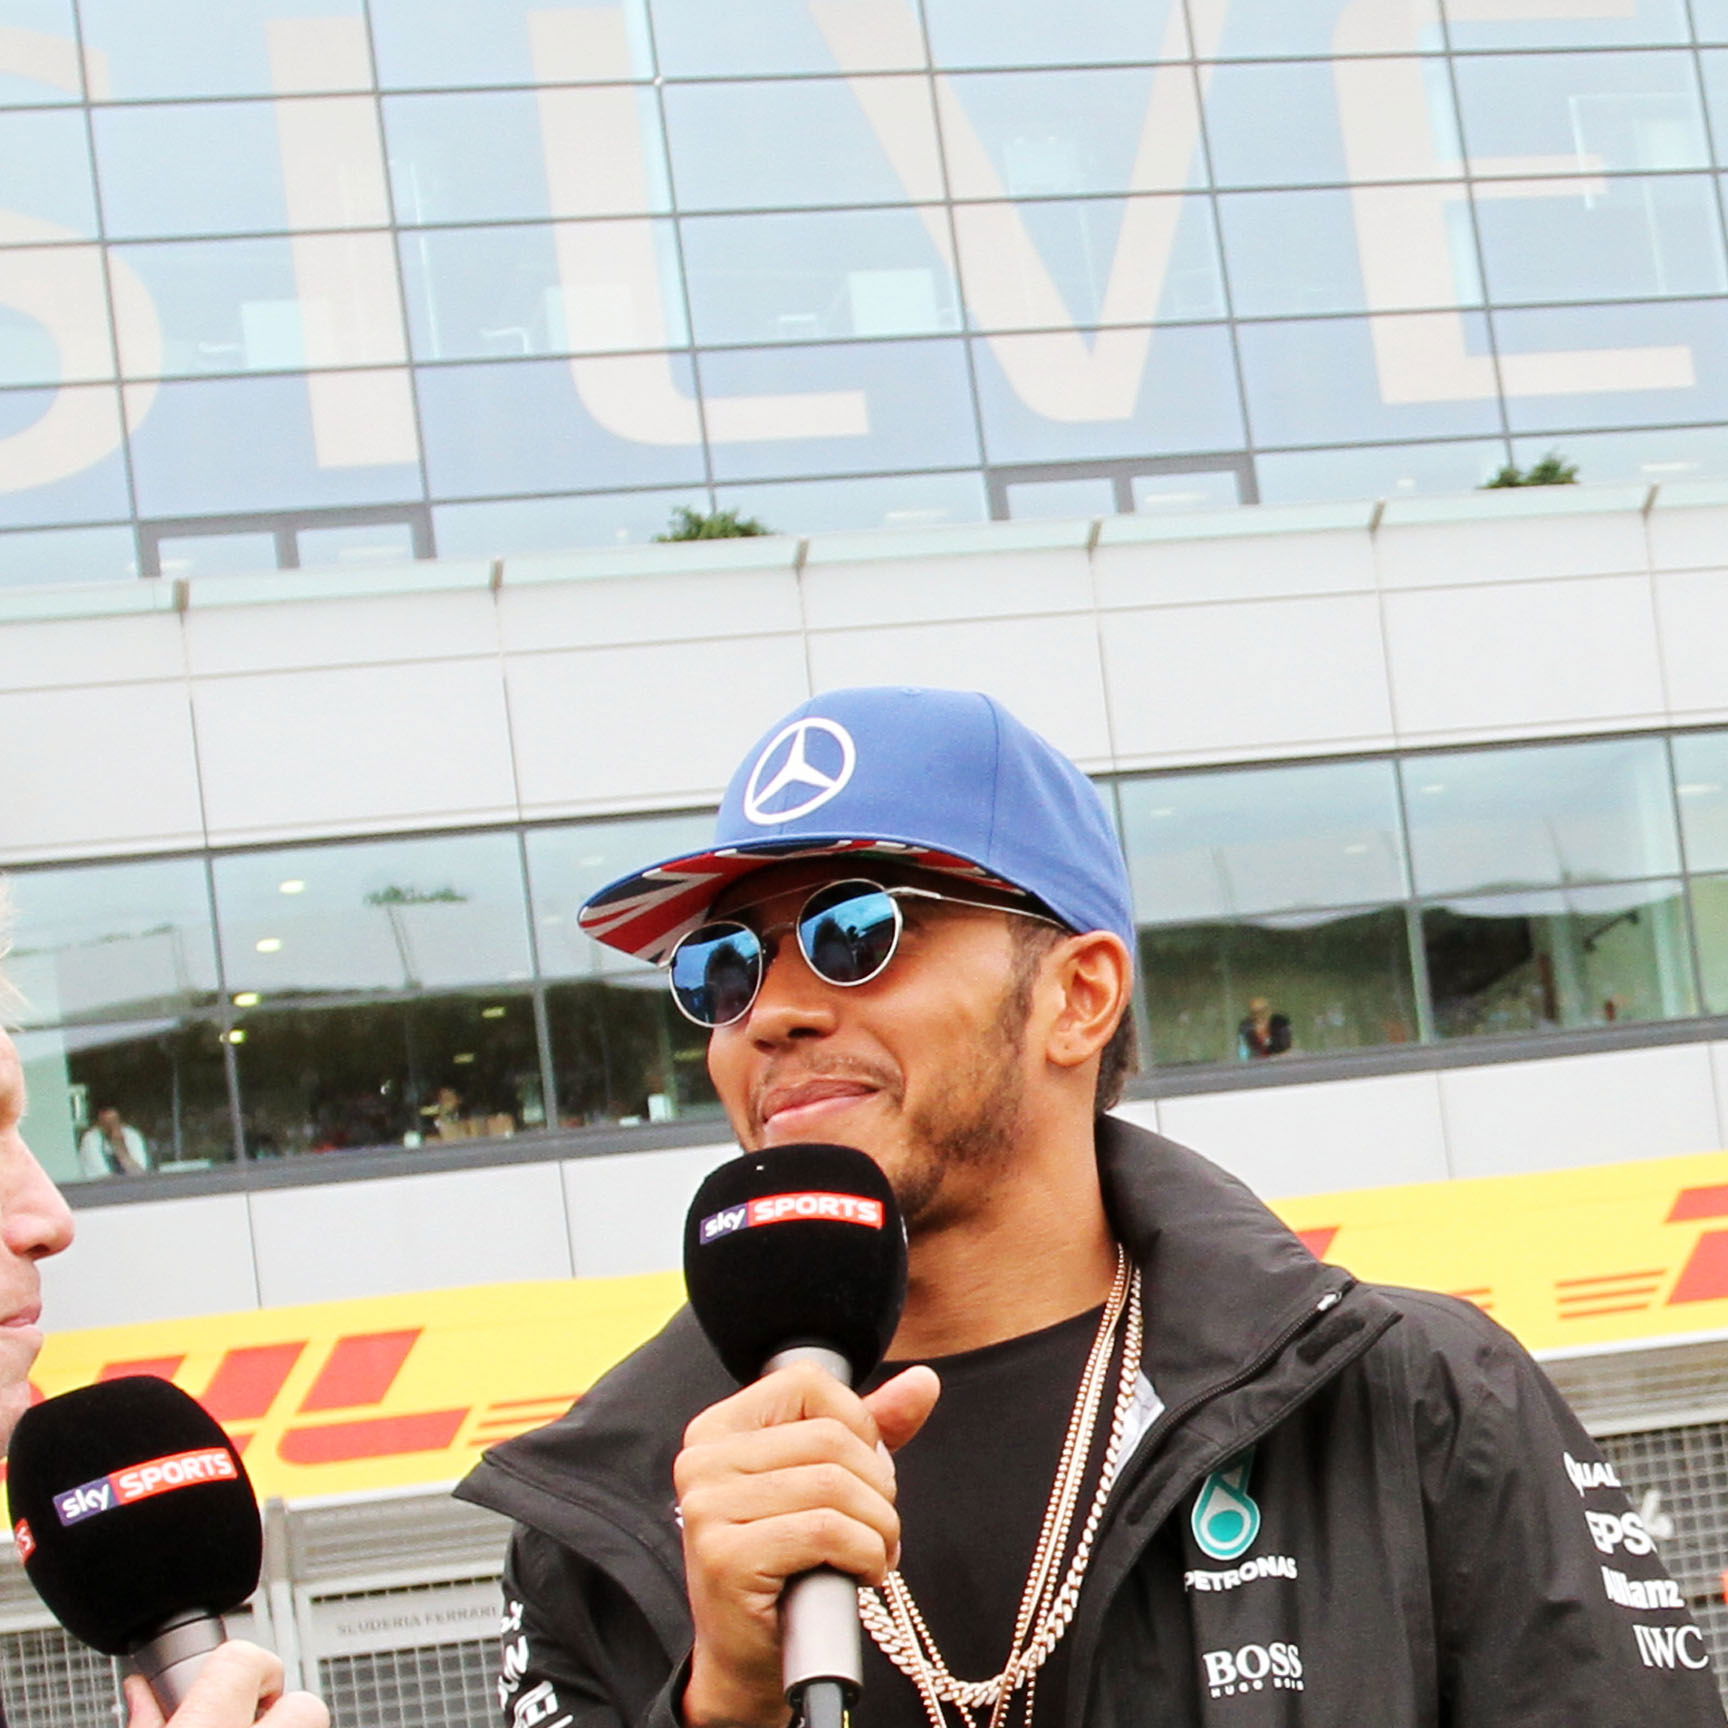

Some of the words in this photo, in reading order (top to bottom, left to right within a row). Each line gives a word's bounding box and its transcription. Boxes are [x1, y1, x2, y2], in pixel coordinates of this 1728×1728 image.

[704, 1207, 746, 1238] sky
[753, 1196, 879, 1223] SPORTS
[60, 1482, 111, 1519] sky
[117, 1453, 233, 1499] SPORTS
[1584, 1510, 1659, 1555] EPS
[1184, 1555, 1298, 1592] PETRONAS
[1202, 1641, 1303, 1687] BOSS
[1632, 1623, 1709, 1670] IWC
